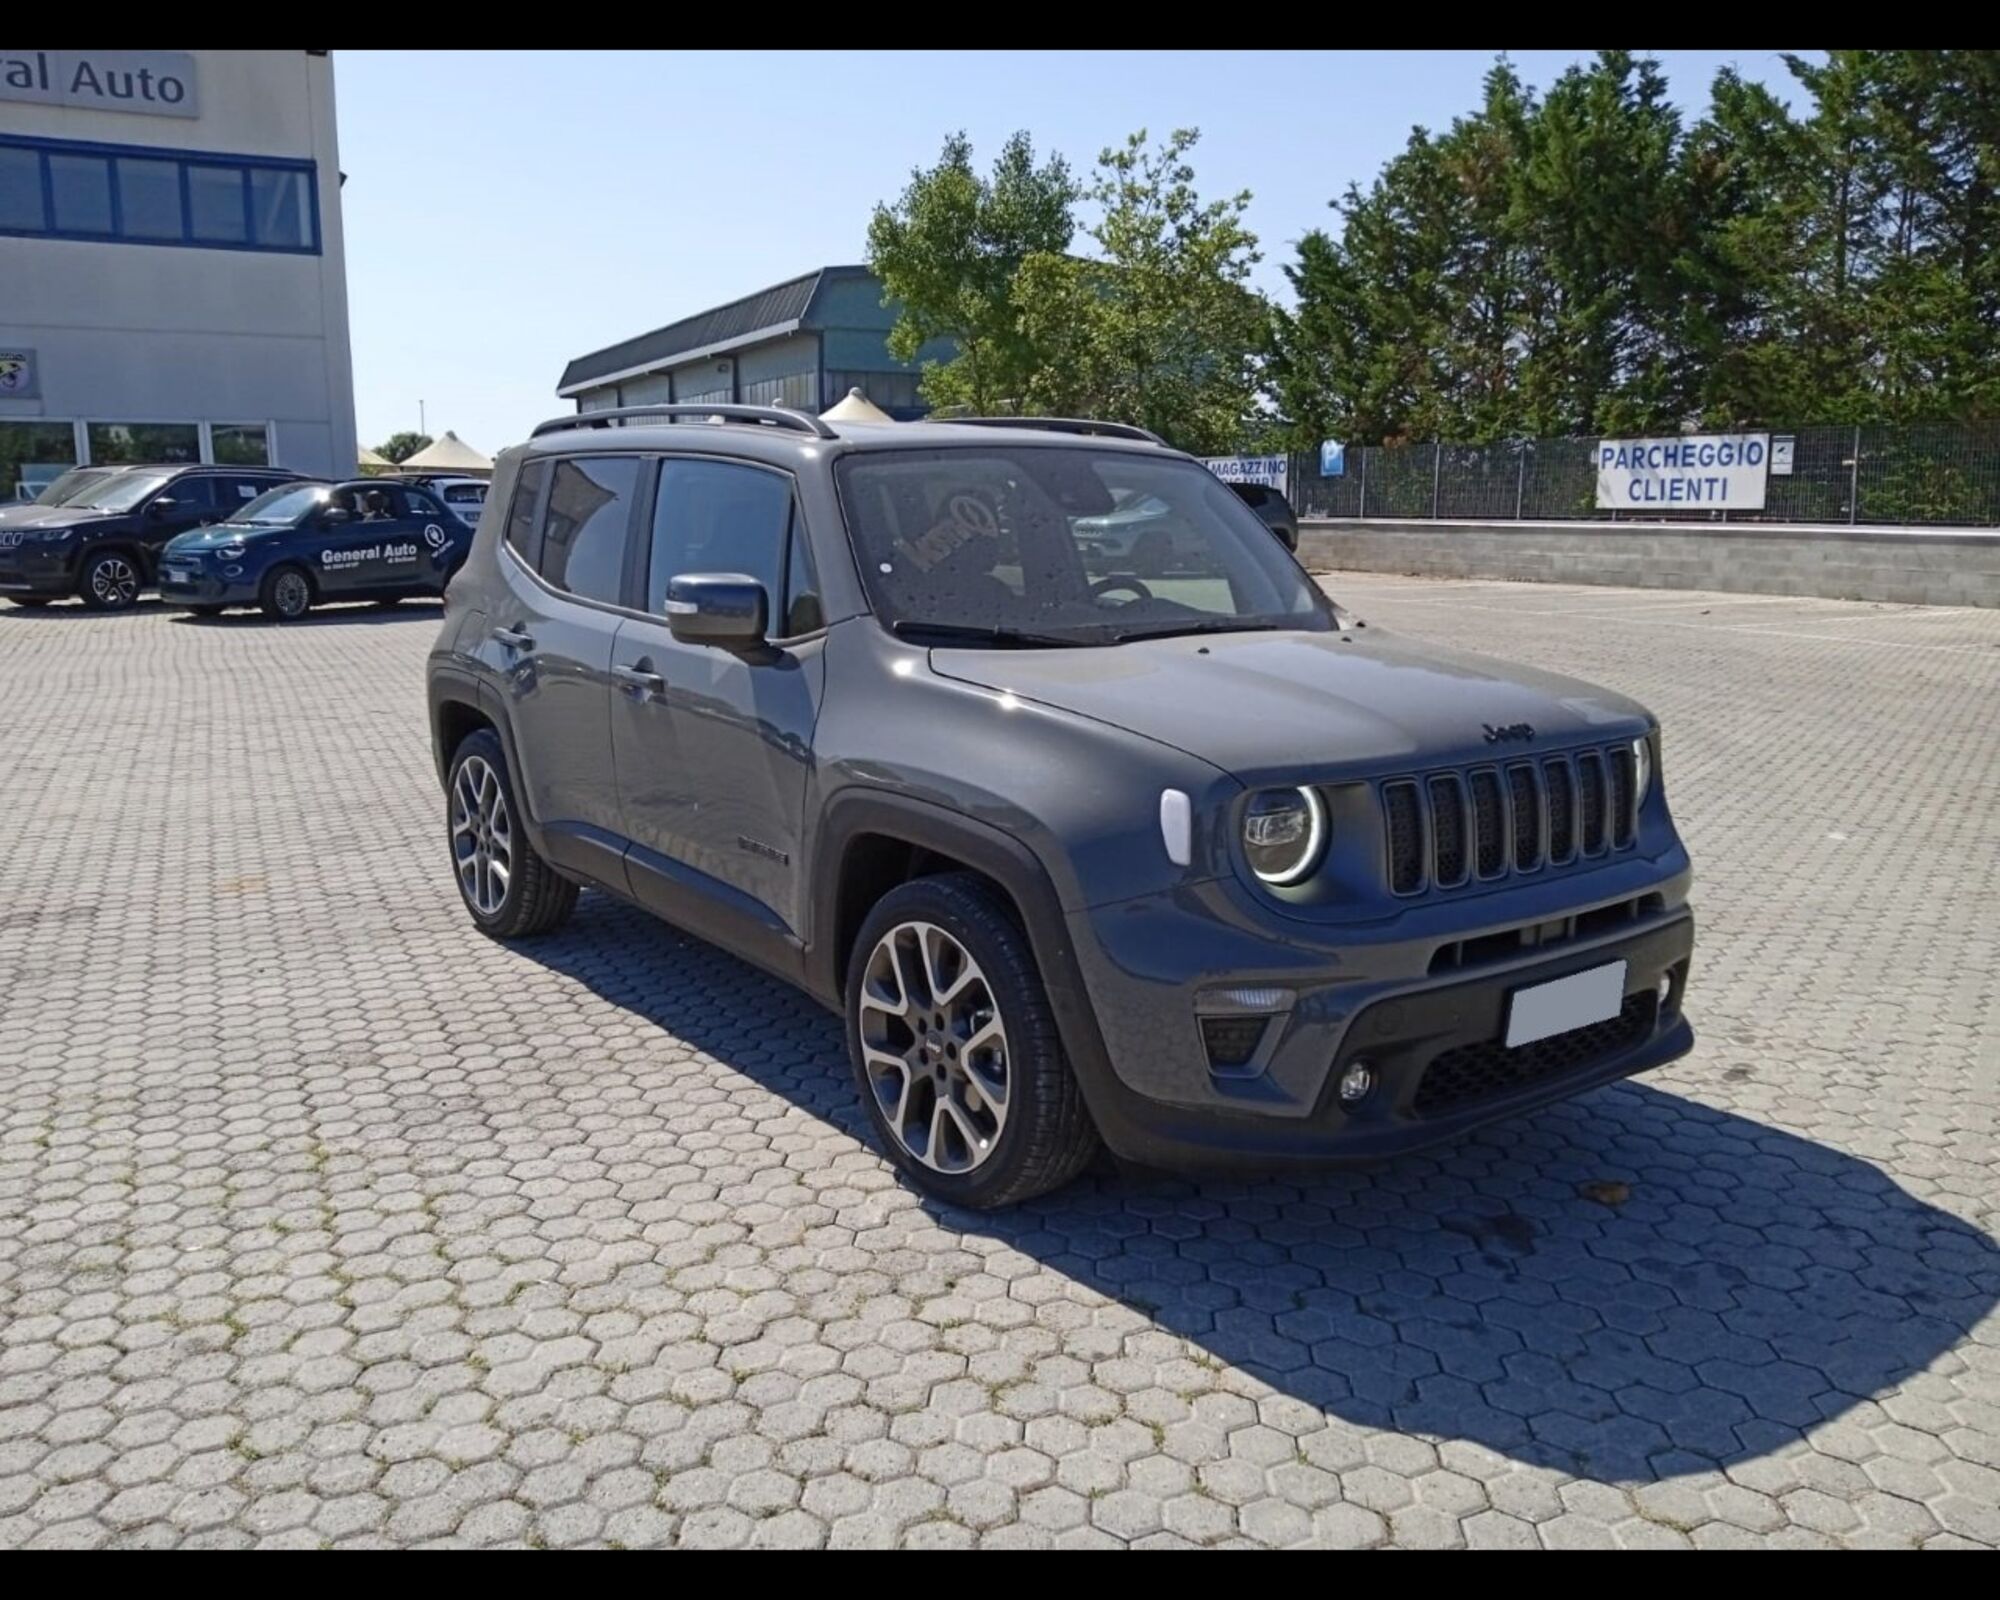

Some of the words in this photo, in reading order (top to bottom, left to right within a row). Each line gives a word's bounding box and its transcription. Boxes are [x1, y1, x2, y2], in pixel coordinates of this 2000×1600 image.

[0, 52, 49, 91] al
[70, 60, 184, 104] Auto
[1601, 441, 1764, 470] PARCHEGGIO
[1628, 477, 1728, 501] CLIENTI
[321, 545, 380, 563] General
[384, 543, 417, 558] Auto
[1482, 723, 1535, 744] Jeep
